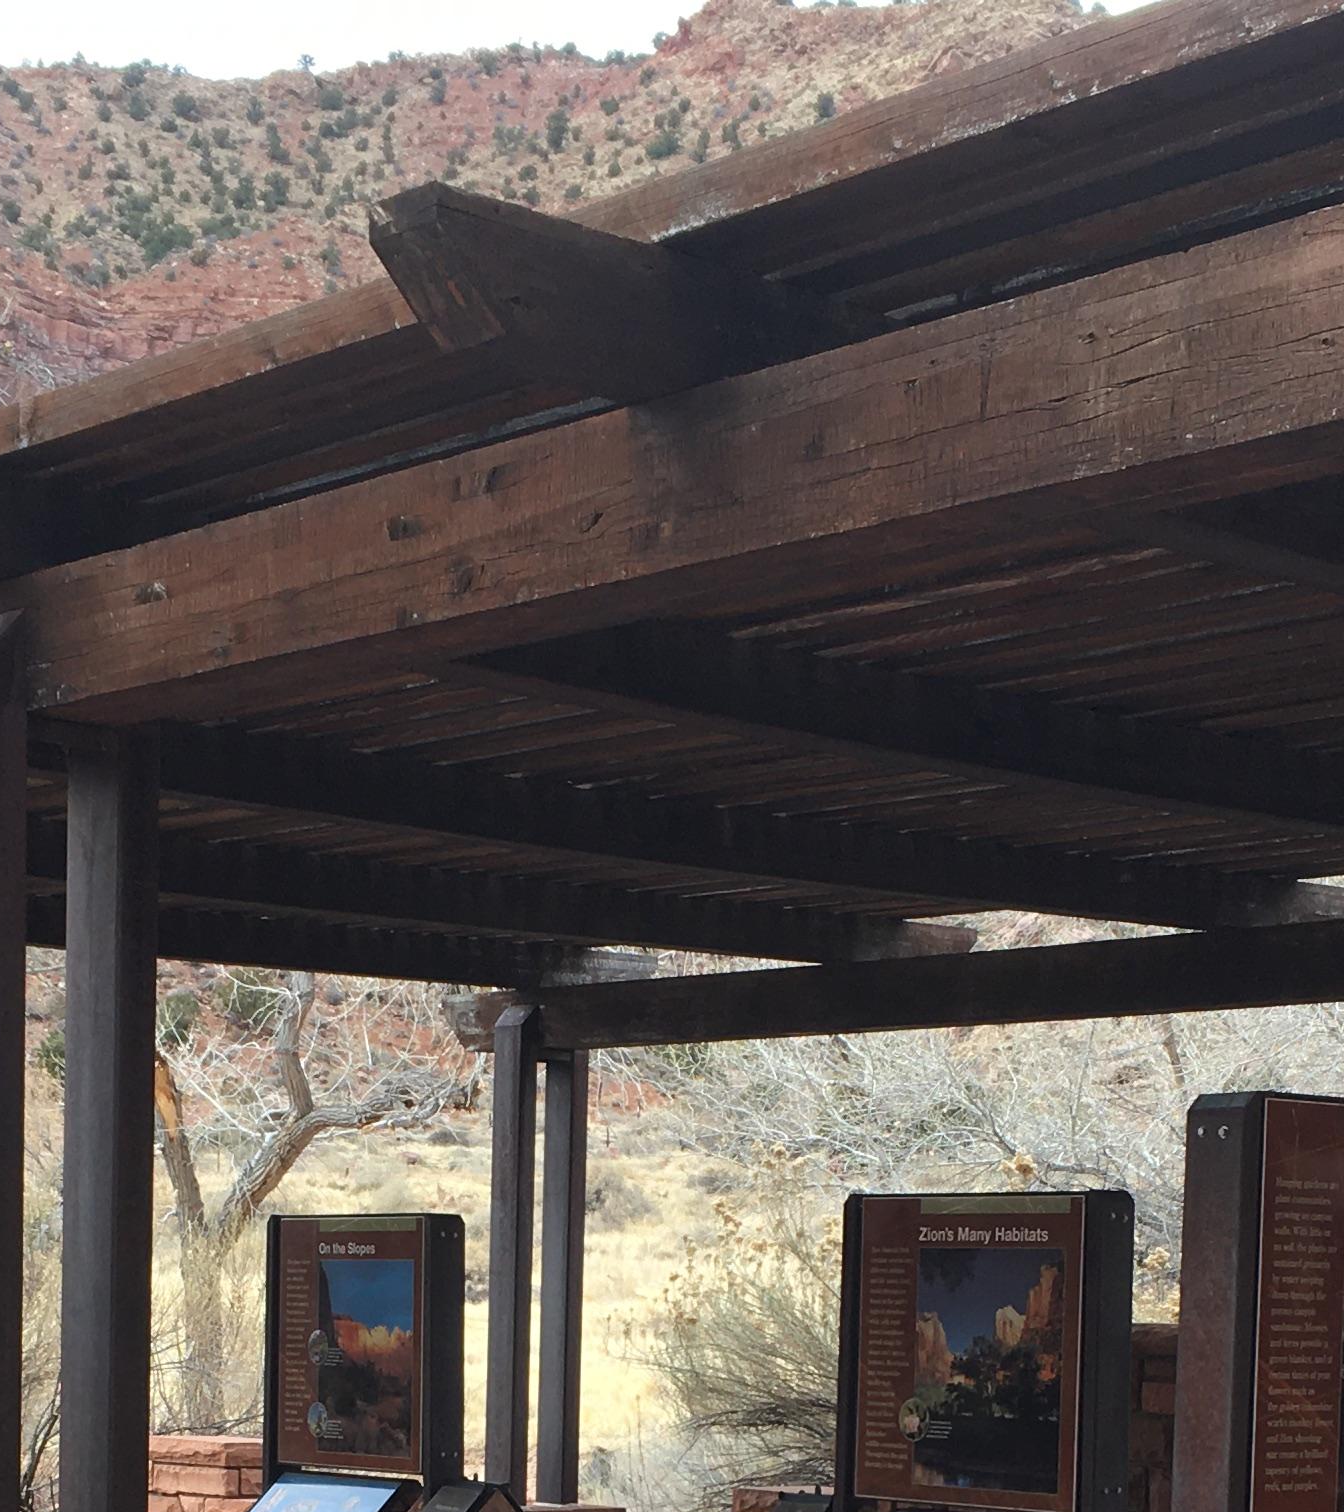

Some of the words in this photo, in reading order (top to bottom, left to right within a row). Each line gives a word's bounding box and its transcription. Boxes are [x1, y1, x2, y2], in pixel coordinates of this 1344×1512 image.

[919, 1226, 954, 1241] Zion's
[958, 1226, 992, 1245] Many
[995, 1226, 1049, 1242] Habitats
[318, 1242, 331, 1254] On
[332, 1242, 346, 1254] the
[347, 1242, 376, 1256] Slopes
